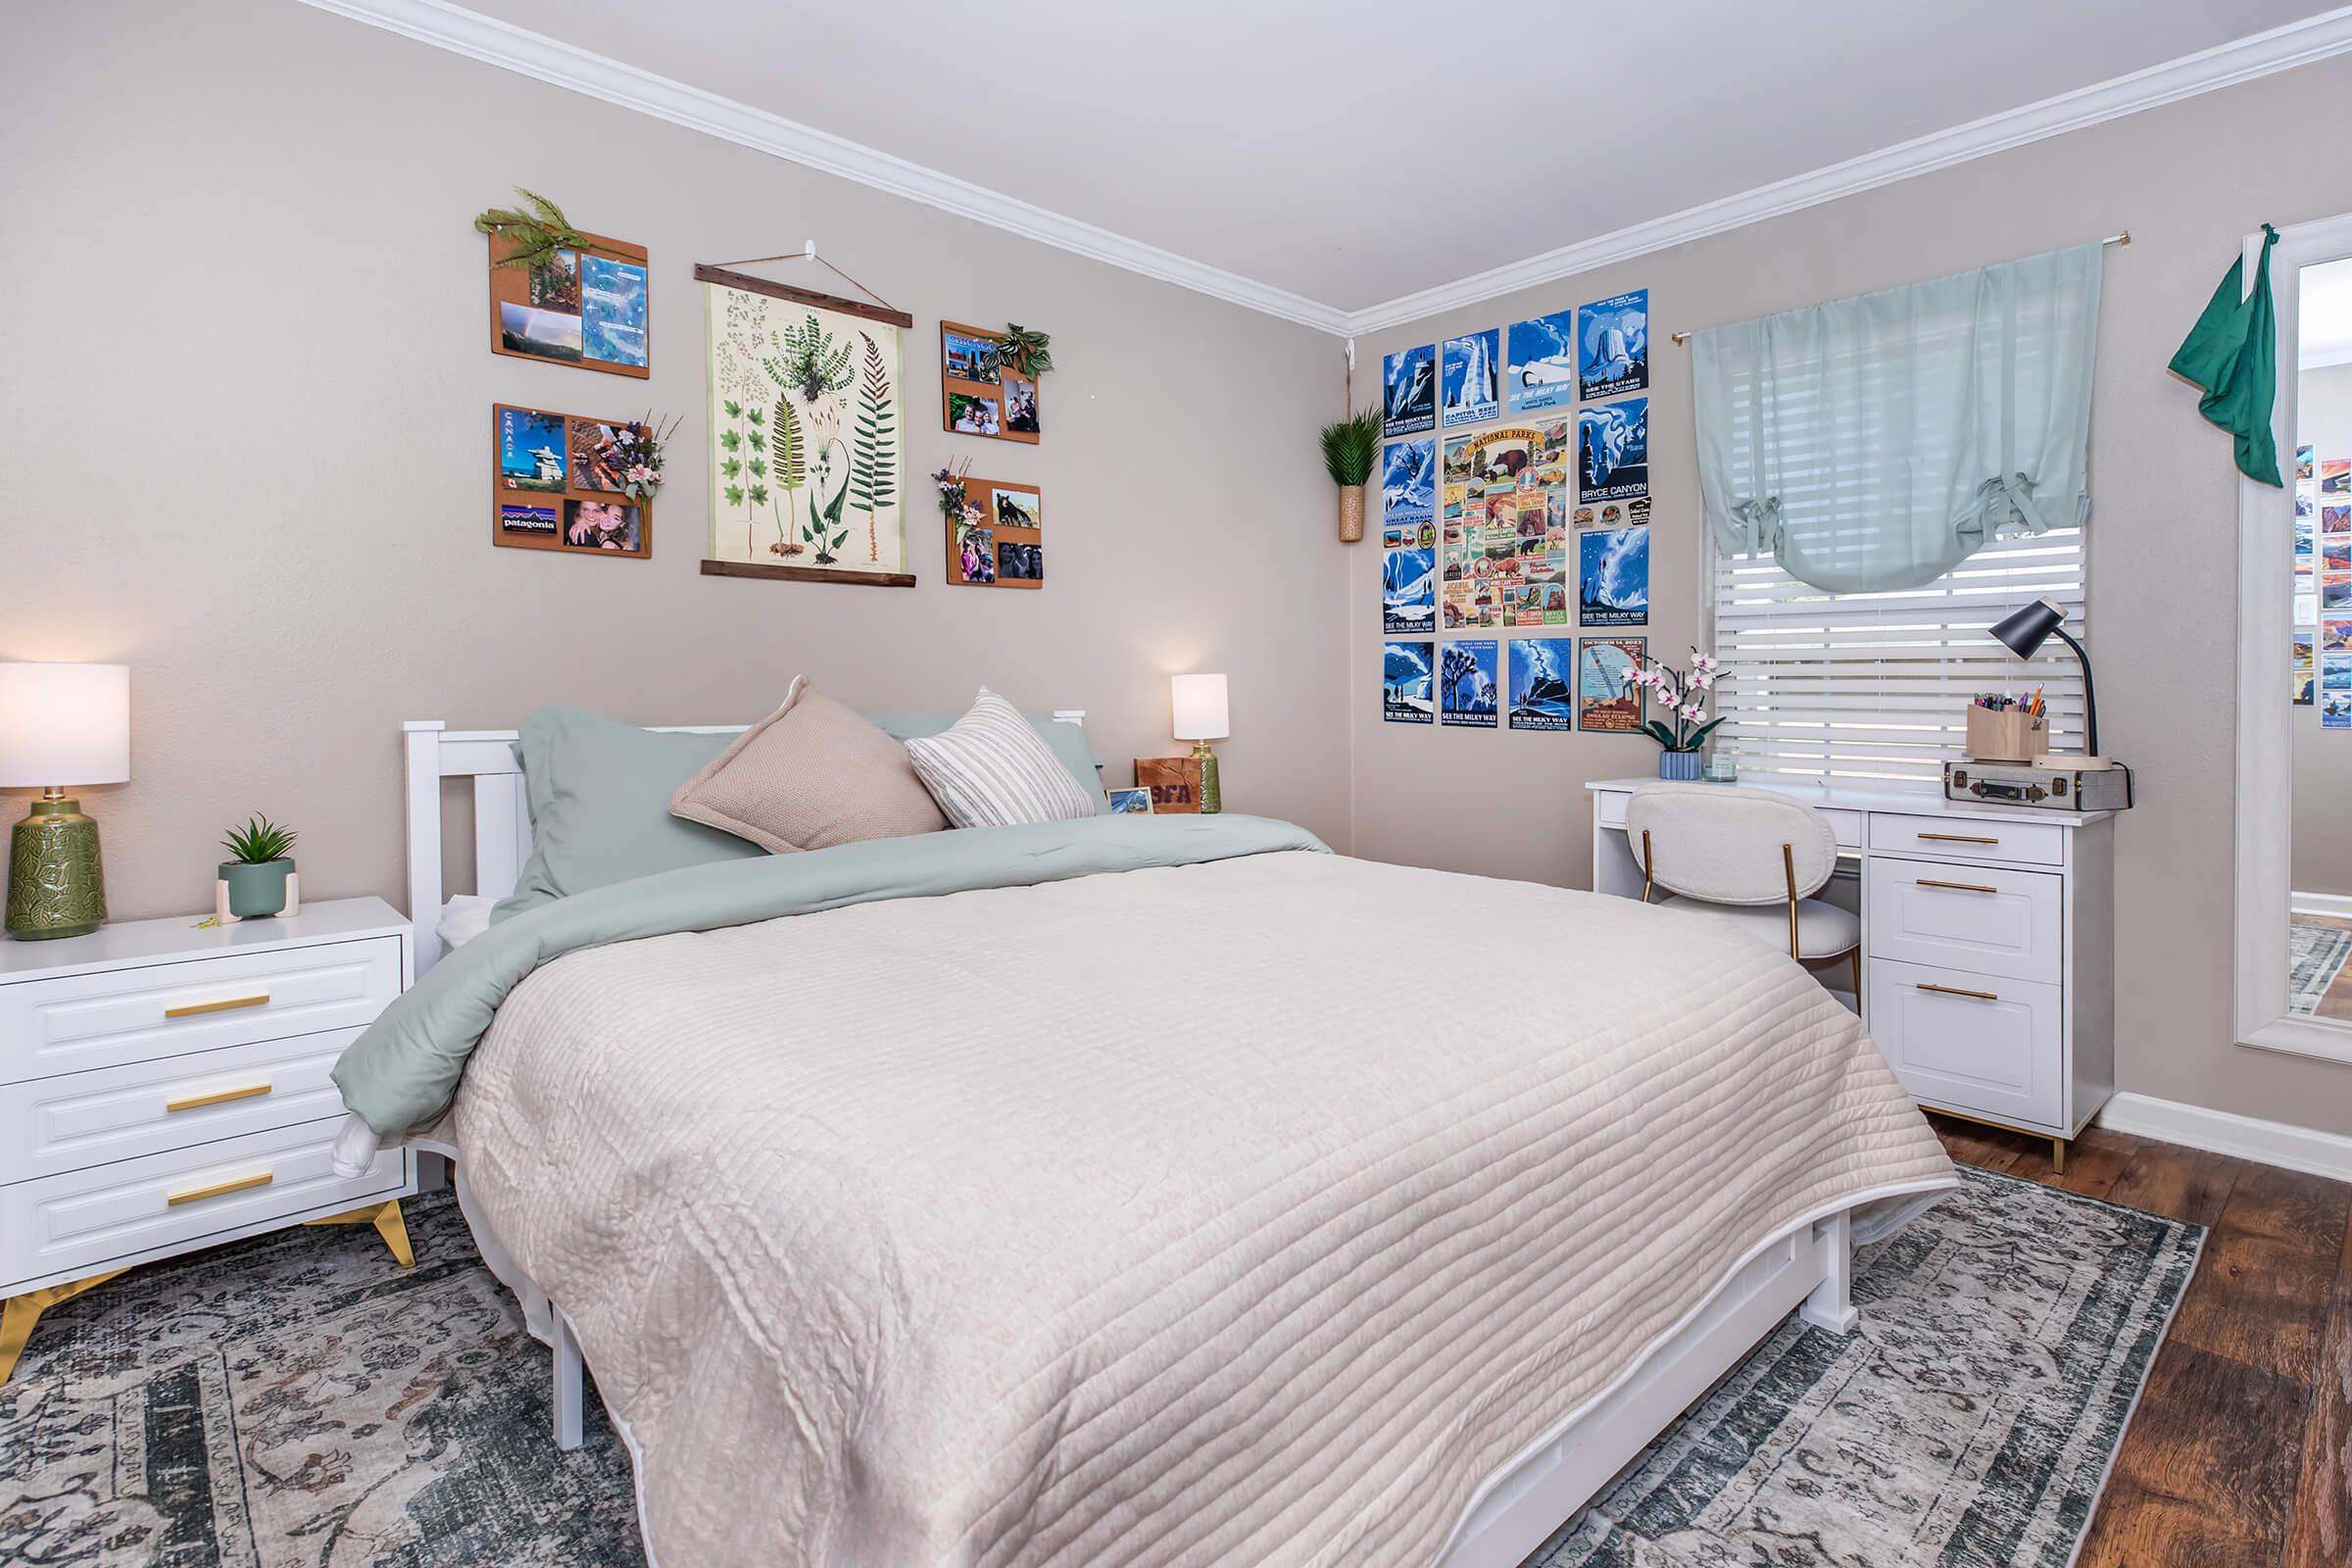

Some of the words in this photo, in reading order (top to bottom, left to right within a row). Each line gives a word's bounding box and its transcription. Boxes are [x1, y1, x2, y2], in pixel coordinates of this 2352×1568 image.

[1446, 410, 1475, 418] CAPITOL
[503, 412, 514, 458] CANADA
[1473, 431, 1508, 449] NATIONAL
[1511, 430, 1537, 439] PARKS
[1581, 488, 1608, 499] BRYCE
[1610, 483, 1647, 494] CANYON
[504, 518, 555, 529] patagonia
[1152, 785, 1193, 804] SFA
